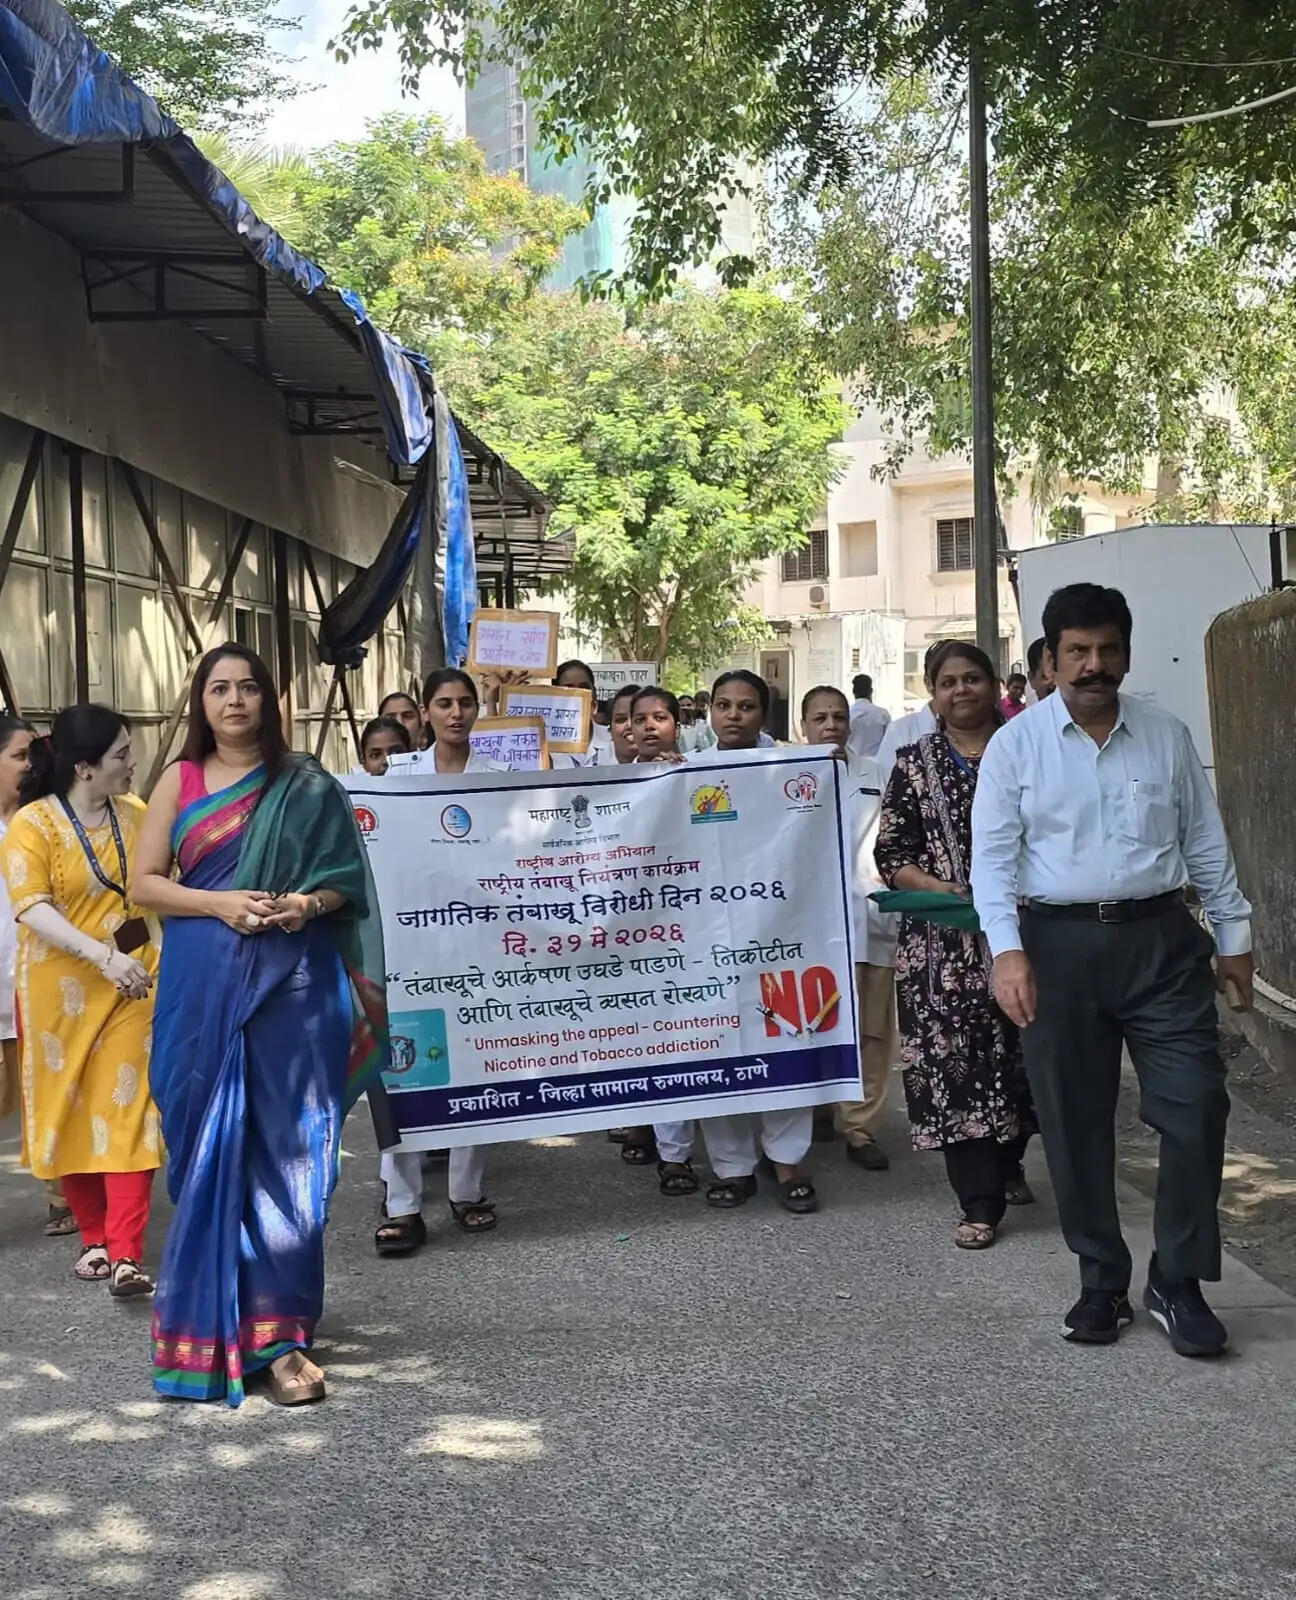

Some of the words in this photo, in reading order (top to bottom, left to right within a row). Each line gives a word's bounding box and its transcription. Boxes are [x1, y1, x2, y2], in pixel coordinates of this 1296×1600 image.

[528, 808, 571, 823] महाराष्ट्र
[594, 801, 631, 816] शासन
[516, 855, 553, 870] राष्ट्रीय
[558, 852, 600, 867] आरोग्य
[606, 845, 656, 861] अभियान
[477, 873, 524, 895] राष्ट्रीय
[529, 871, 579, 892] तंबाखू
[579, 864, 638, 886] नियंत्रण
[642, 856, 700, 878] कार्यक्रम
[396, 901, 500, 928] जागतिक
[505, 894, 583, 924] तंबाखू
[582, 887, 654, 917] विरोधी
[659, 884, 702, 911] दिन
[710, 880, 787, 903] २०२६
[502, 931, 537, 957] दि.
[547, 935, 582, 956] ३१
[590, 926, 608, 948] मे
[615, 923, 685, 947] २०२६
[576, 954, 624, 981] उघडे
[630, 948, 686, 975] पाडणे
[712, 937, 804, 968] निकोटीन
[457, 998, 513, 1025] आणि
[518, 990, 593, 1022] तंबाखूचे
[597, 990, 657, 1010] व्यसन
[759, 966, 840, 1037] NO
[562, 1028, 585, 1042] the
[589, 1022, 639, 1042] appeal
[653, 1013, 741, 1032] Countering
[484, 1055, 546, 1073] Nicotine
[550, 1051, 578, 1066] and
[581, 1047, 643, 1063] Tobacco
[448, 1088, 520, 1115] प्रकाशित
[538, 1082, 586, 1104] जिल्हा
[590, 1077, 649, 1099] सामान्य
[734, 1058, 769, 1081] ठाणे
